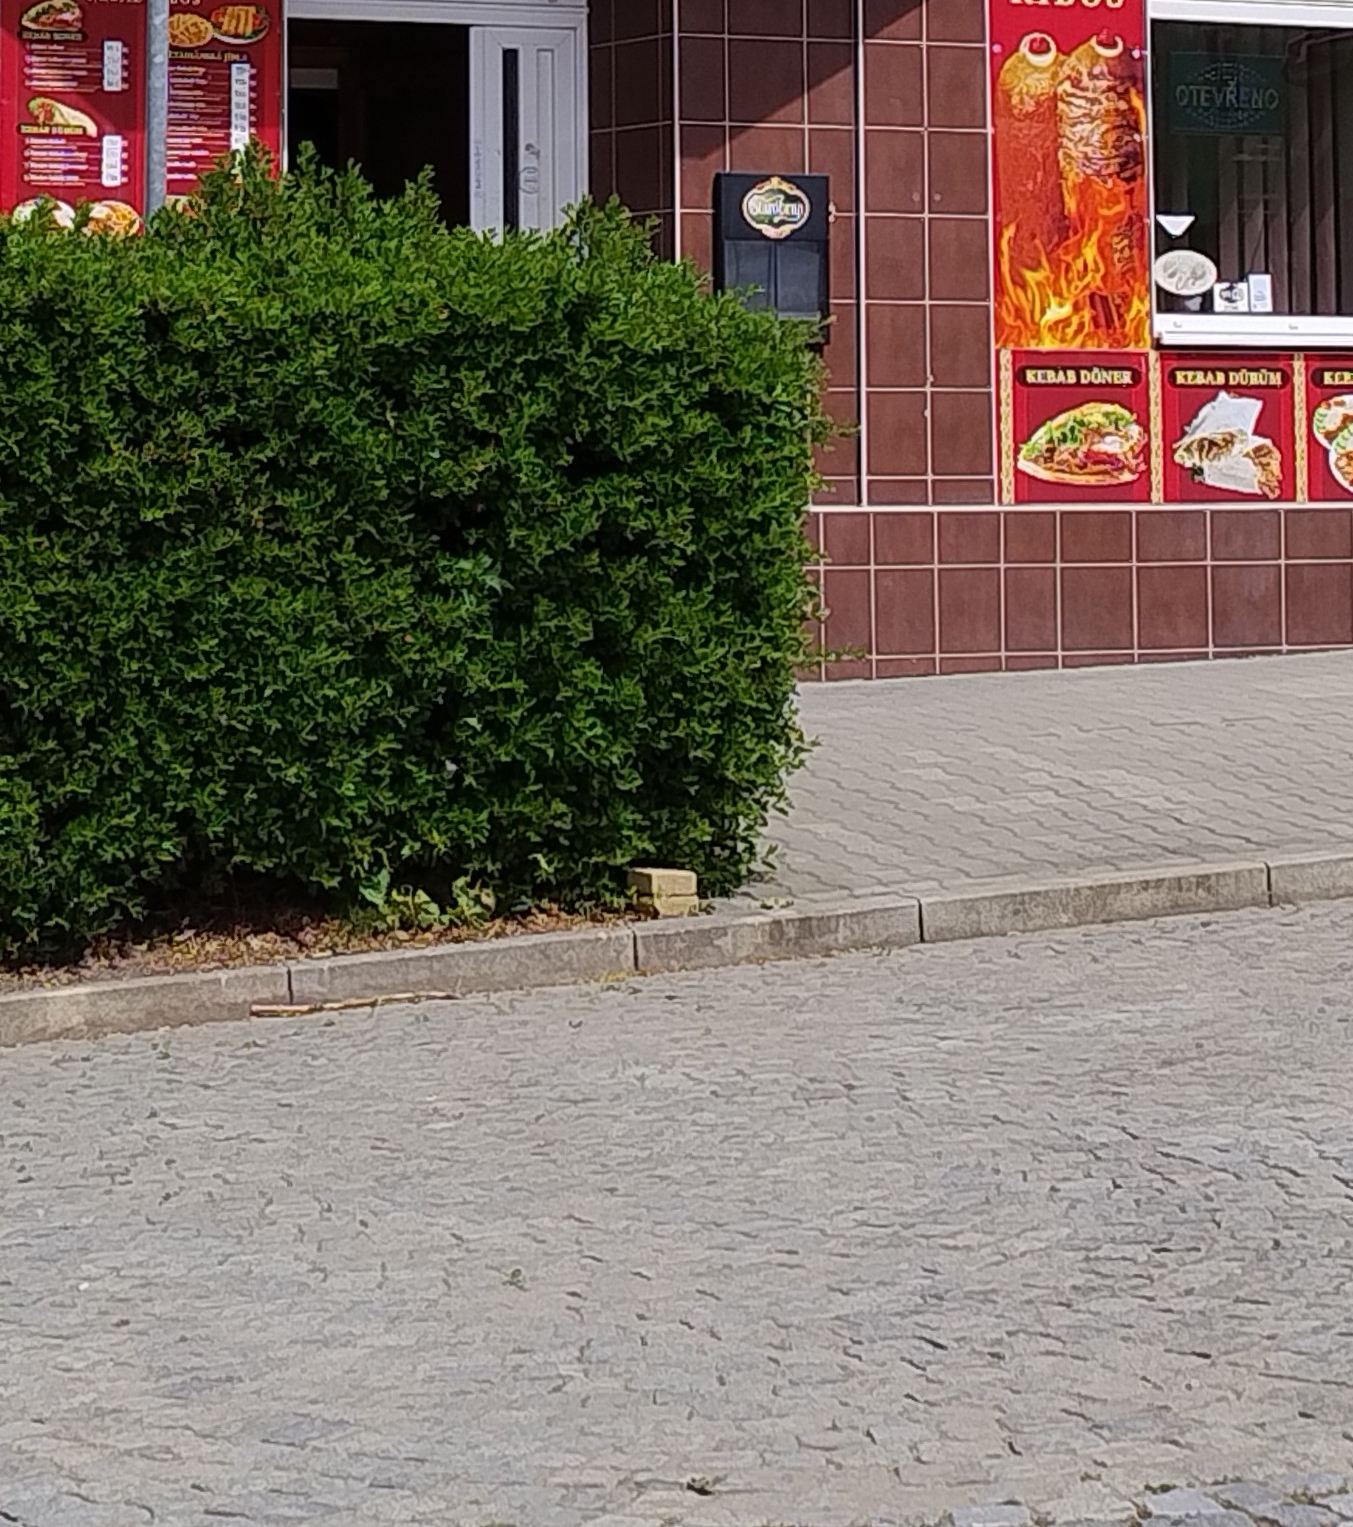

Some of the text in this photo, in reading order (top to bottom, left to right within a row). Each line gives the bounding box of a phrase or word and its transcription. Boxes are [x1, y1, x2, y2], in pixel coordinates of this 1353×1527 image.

[1025, 367, 1133, 385] KEBAB DÖNER
[1175, 368, 1282, 387] KEBAB DÜRÜM
